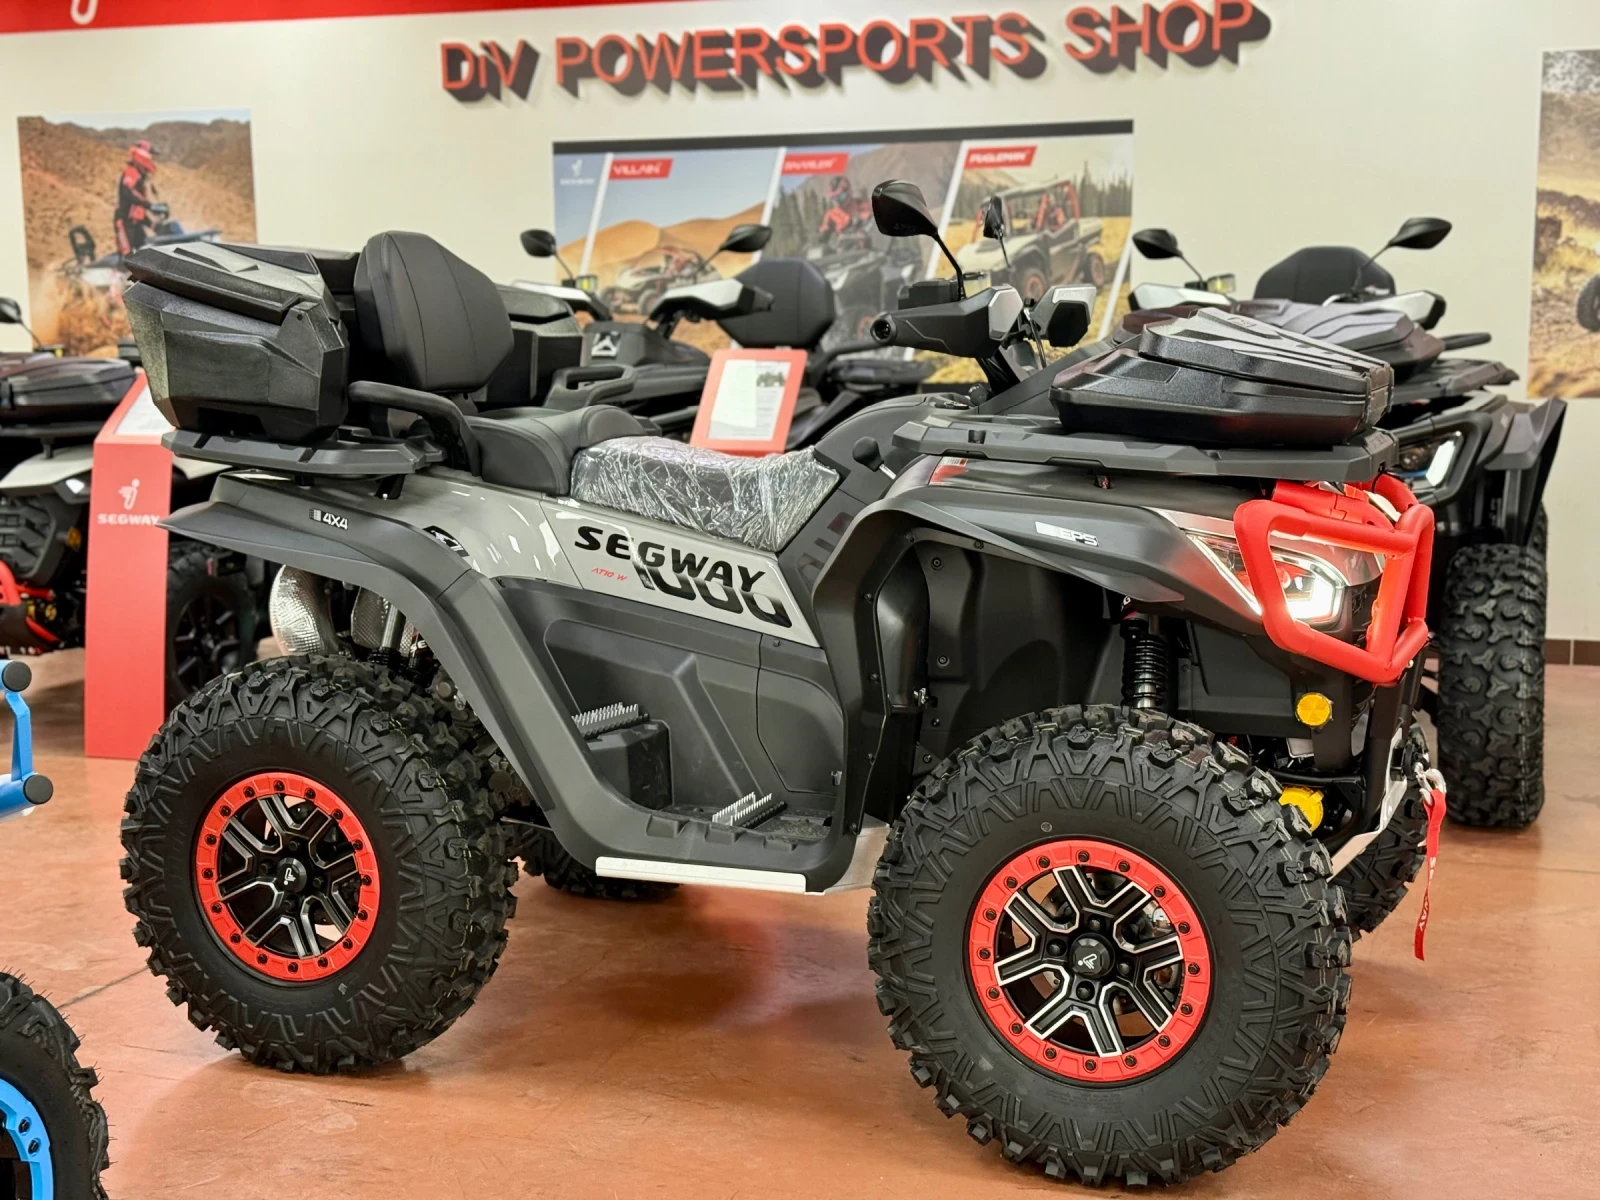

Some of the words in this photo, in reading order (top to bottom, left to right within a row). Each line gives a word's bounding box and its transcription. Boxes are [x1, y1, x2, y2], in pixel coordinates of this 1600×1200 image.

[555, 12, 1031, 87] POWERSPORTS
[1064, 0, 1254, 61] SHOP
[97, 513, 160, 525] SEGWAY
[322, 512, 348, 530] 4X4
[1059, 526, 1098, 547] EPS
[574, 526, 766, 592] SEGWAY
